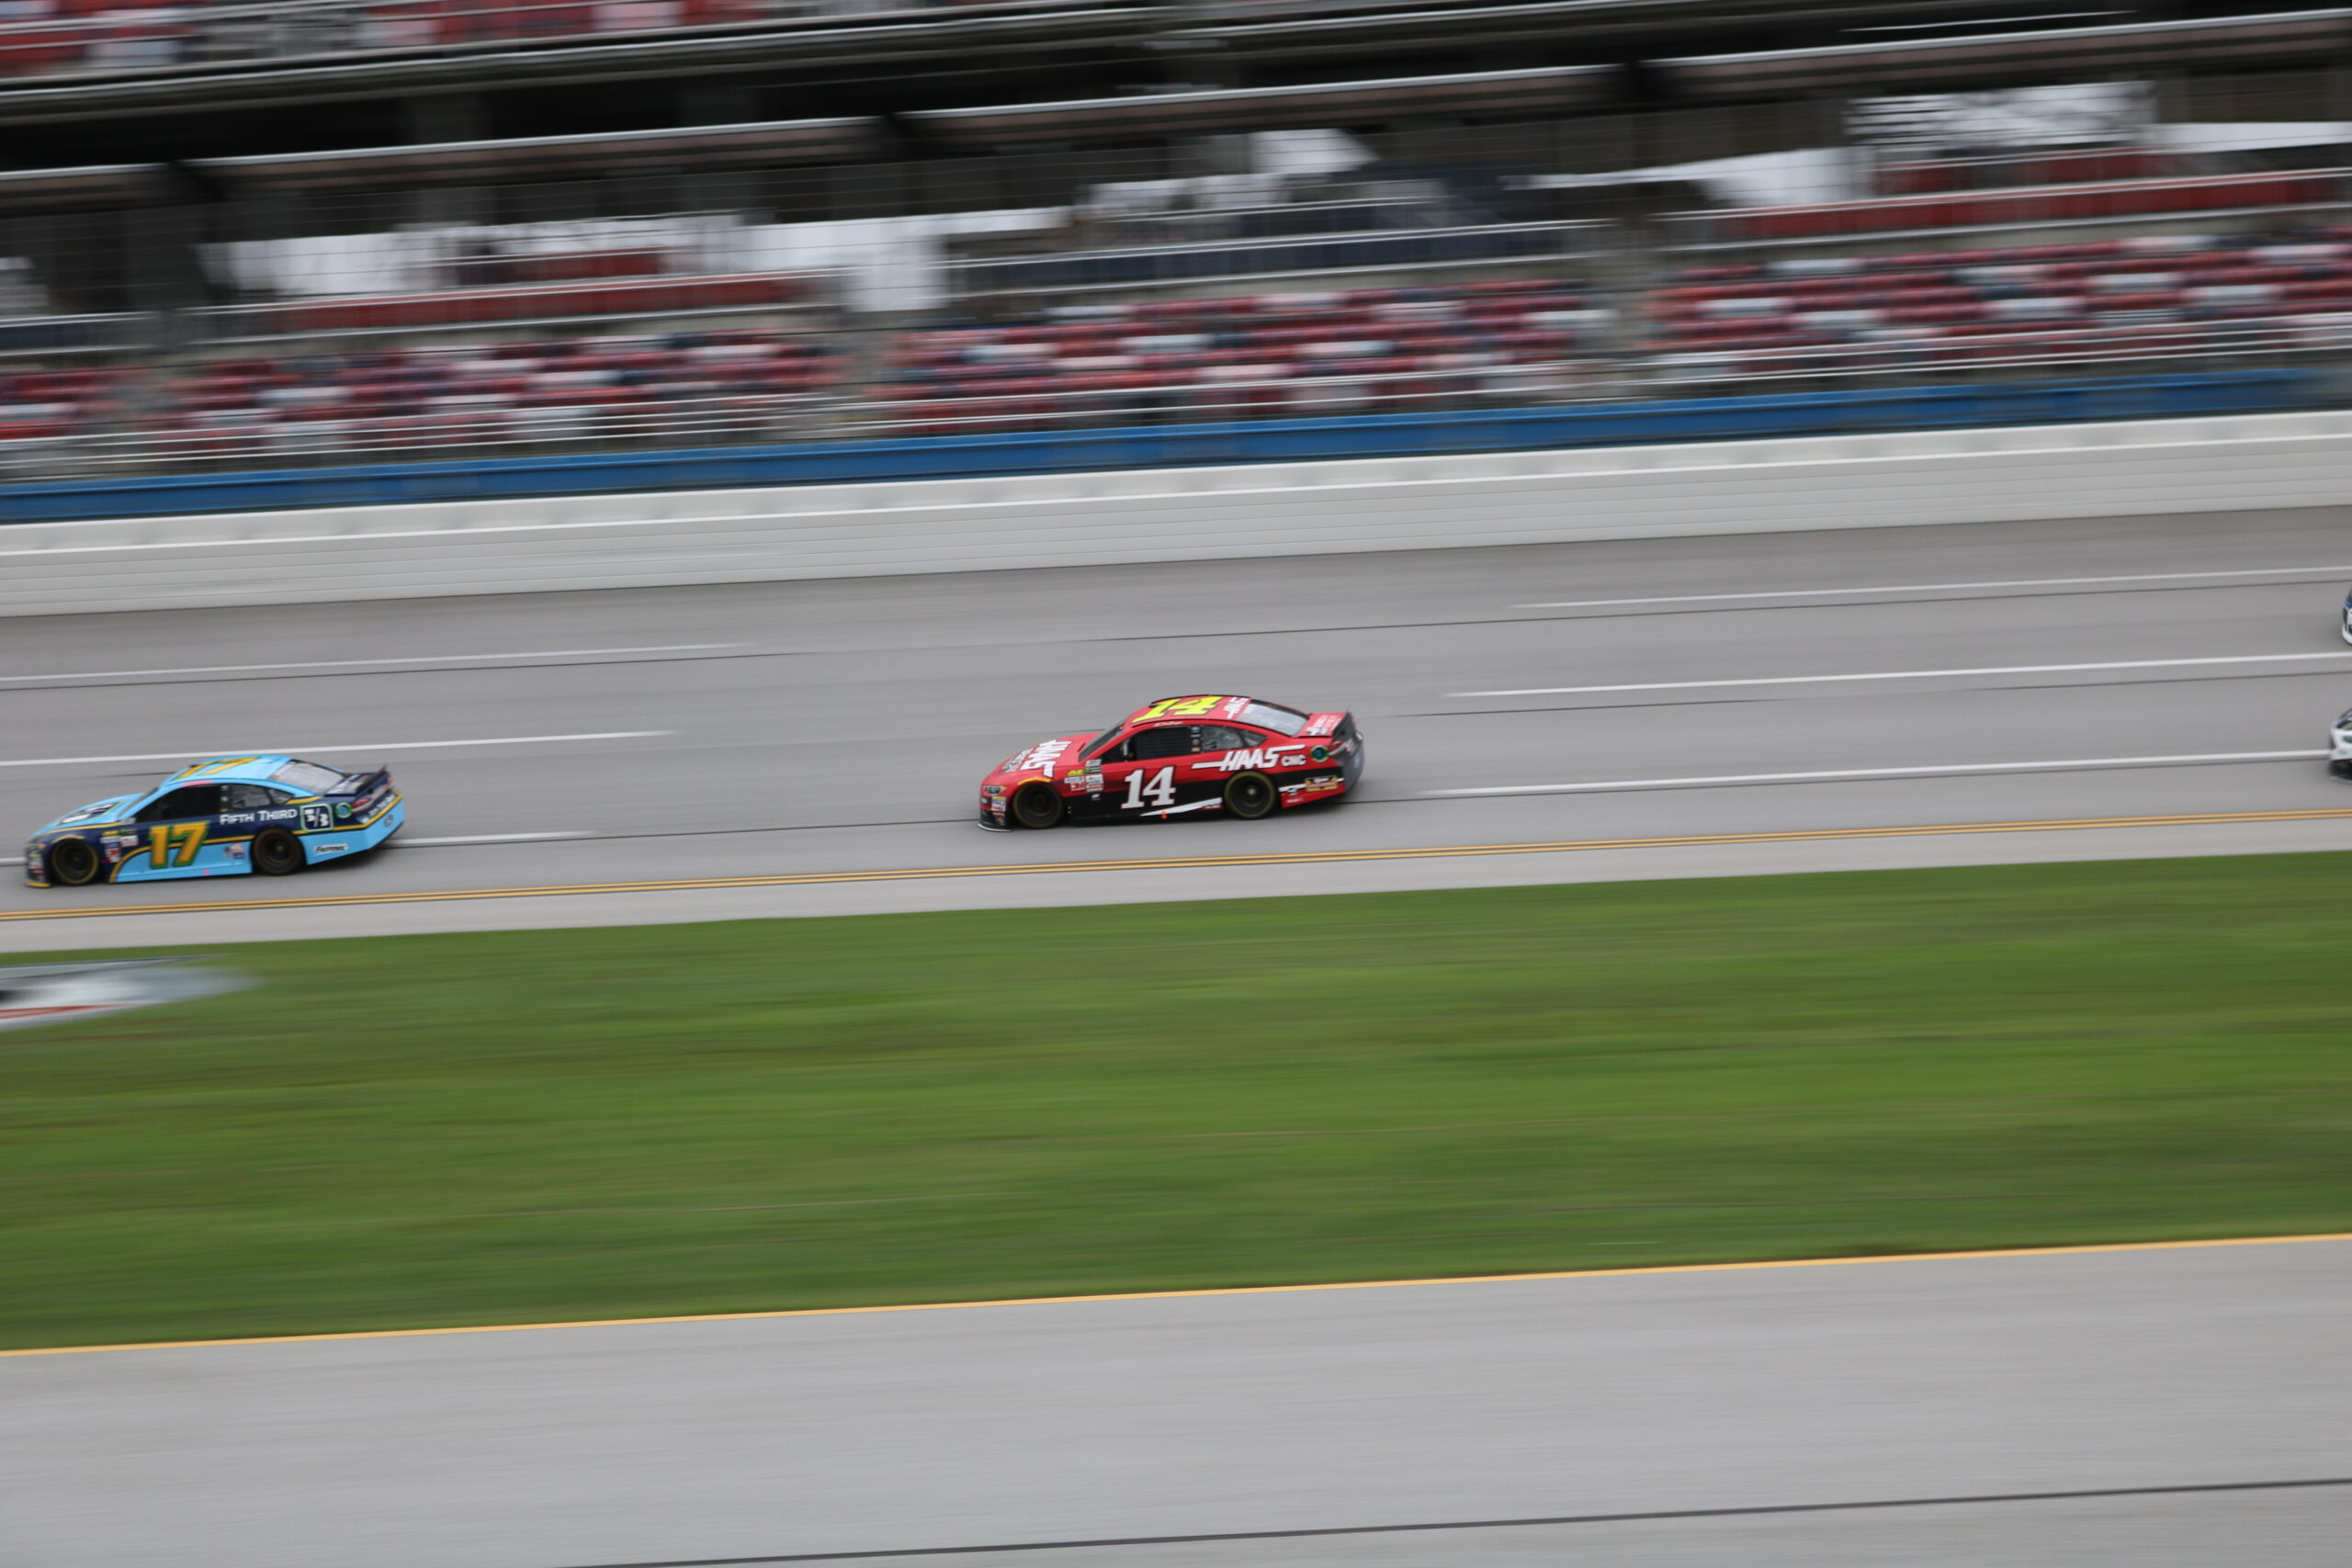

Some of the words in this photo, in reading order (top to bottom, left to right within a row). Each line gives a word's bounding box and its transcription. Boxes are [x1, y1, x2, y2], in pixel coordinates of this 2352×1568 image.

[1131, 696, 1223, 724] 14
[1192, 745, 1306, 772] HAAS
[1120, 766, 1177, 809] 14
[220, 812, 255, 826] FIFTH
[257, 809, 299, 822] THIRD
[148, 820, 211, 869] 17
